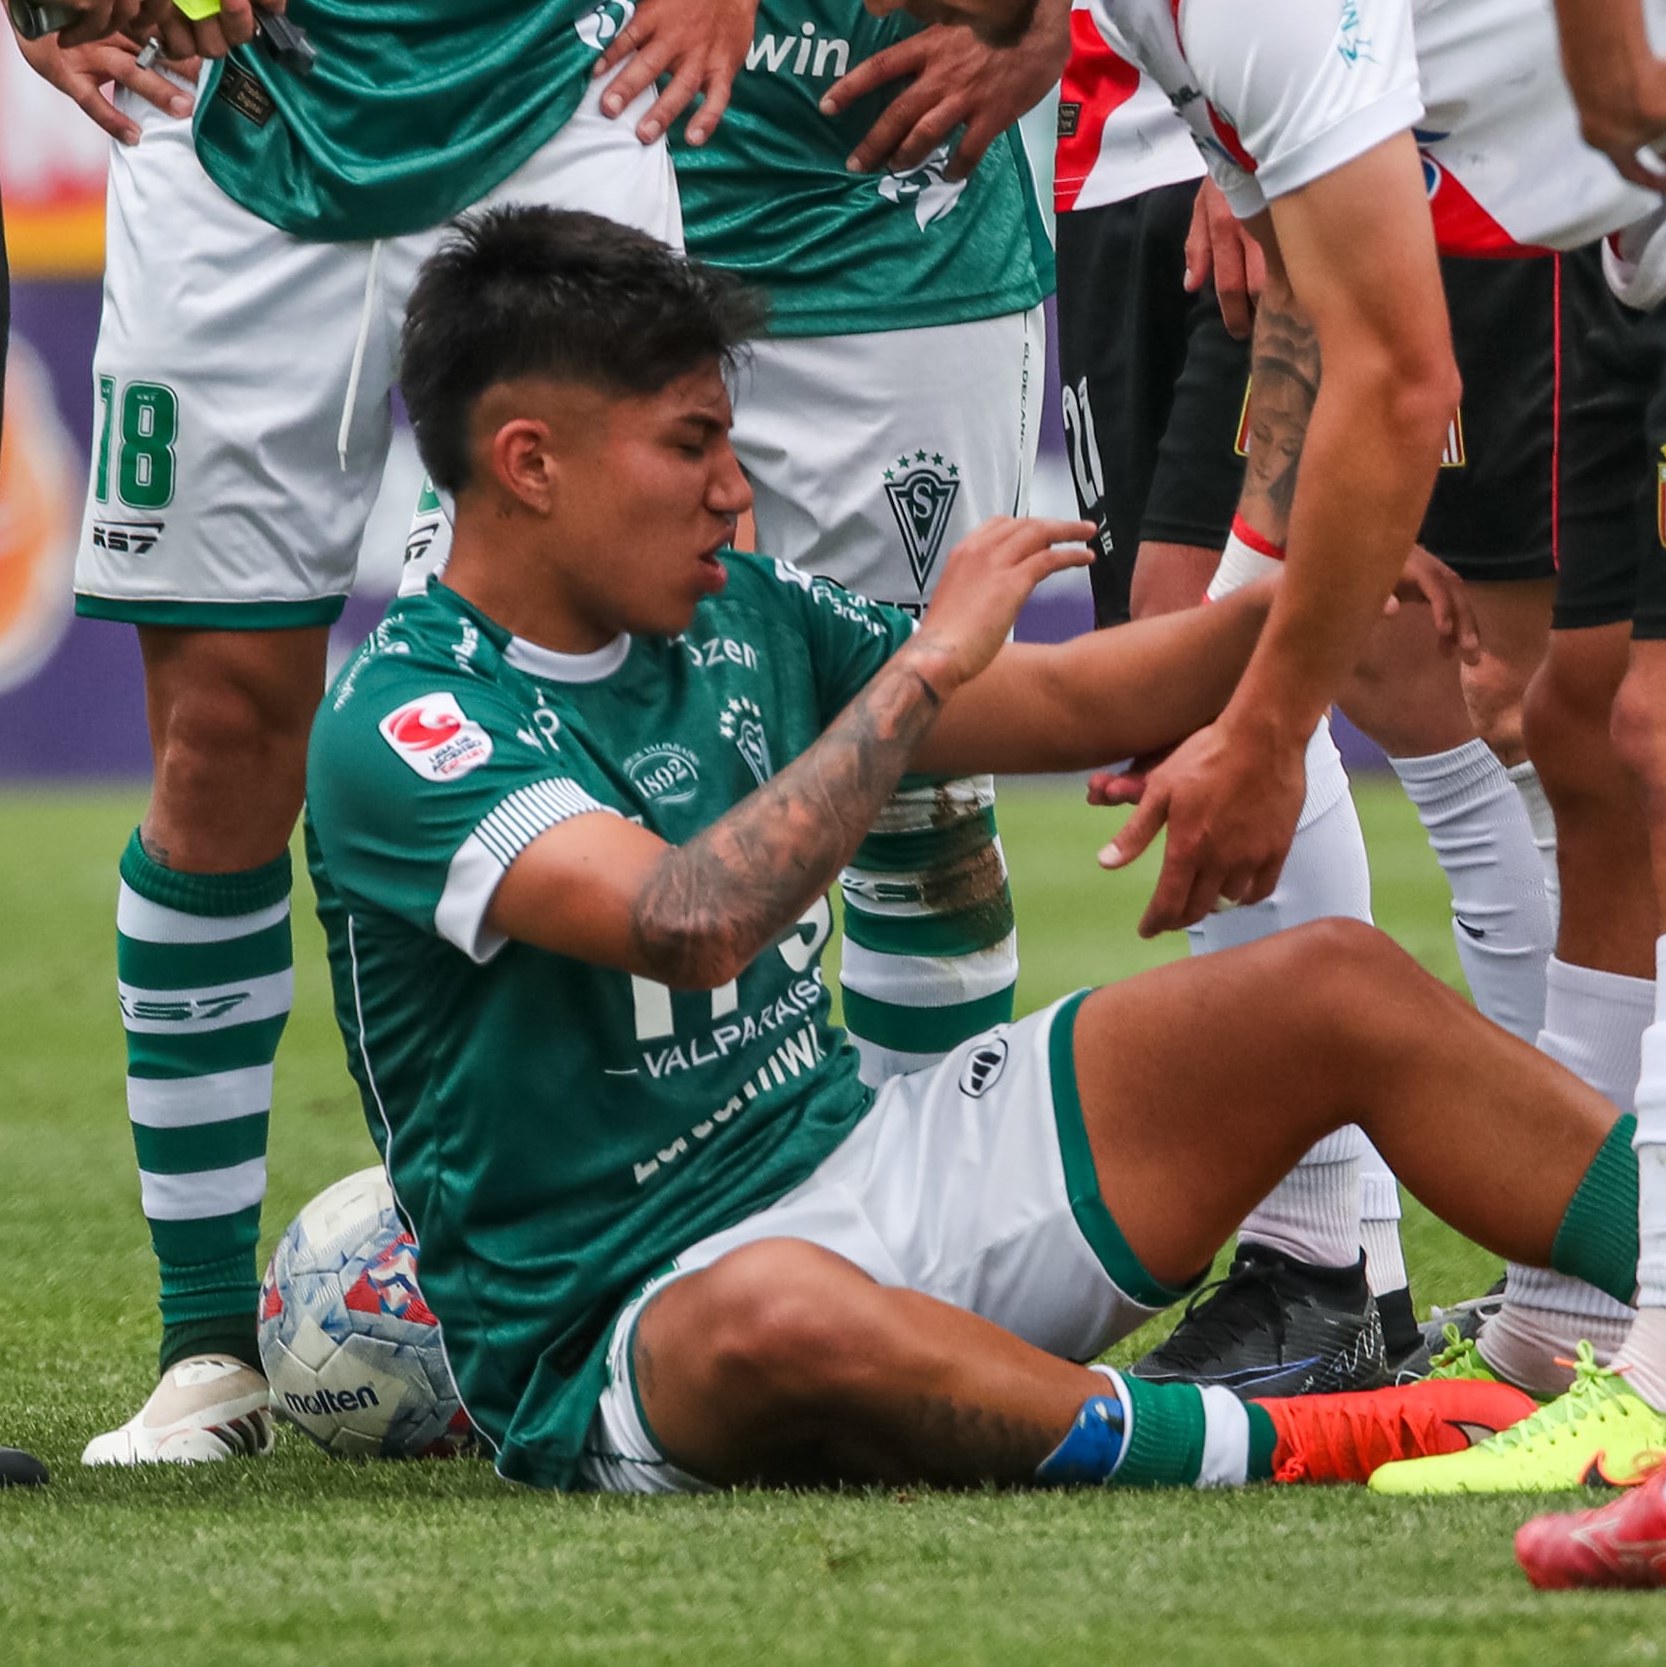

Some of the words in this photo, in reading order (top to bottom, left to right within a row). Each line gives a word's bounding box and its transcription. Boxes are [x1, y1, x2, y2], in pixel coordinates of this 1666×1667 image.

[96, 374, 179, 510] 18
[1062, 375, 1105, 510] 21
[93, 526, 158, 554] KS7
[635, 757, 688, 799] 1892
[284, 1384, 380, 1416] molten
